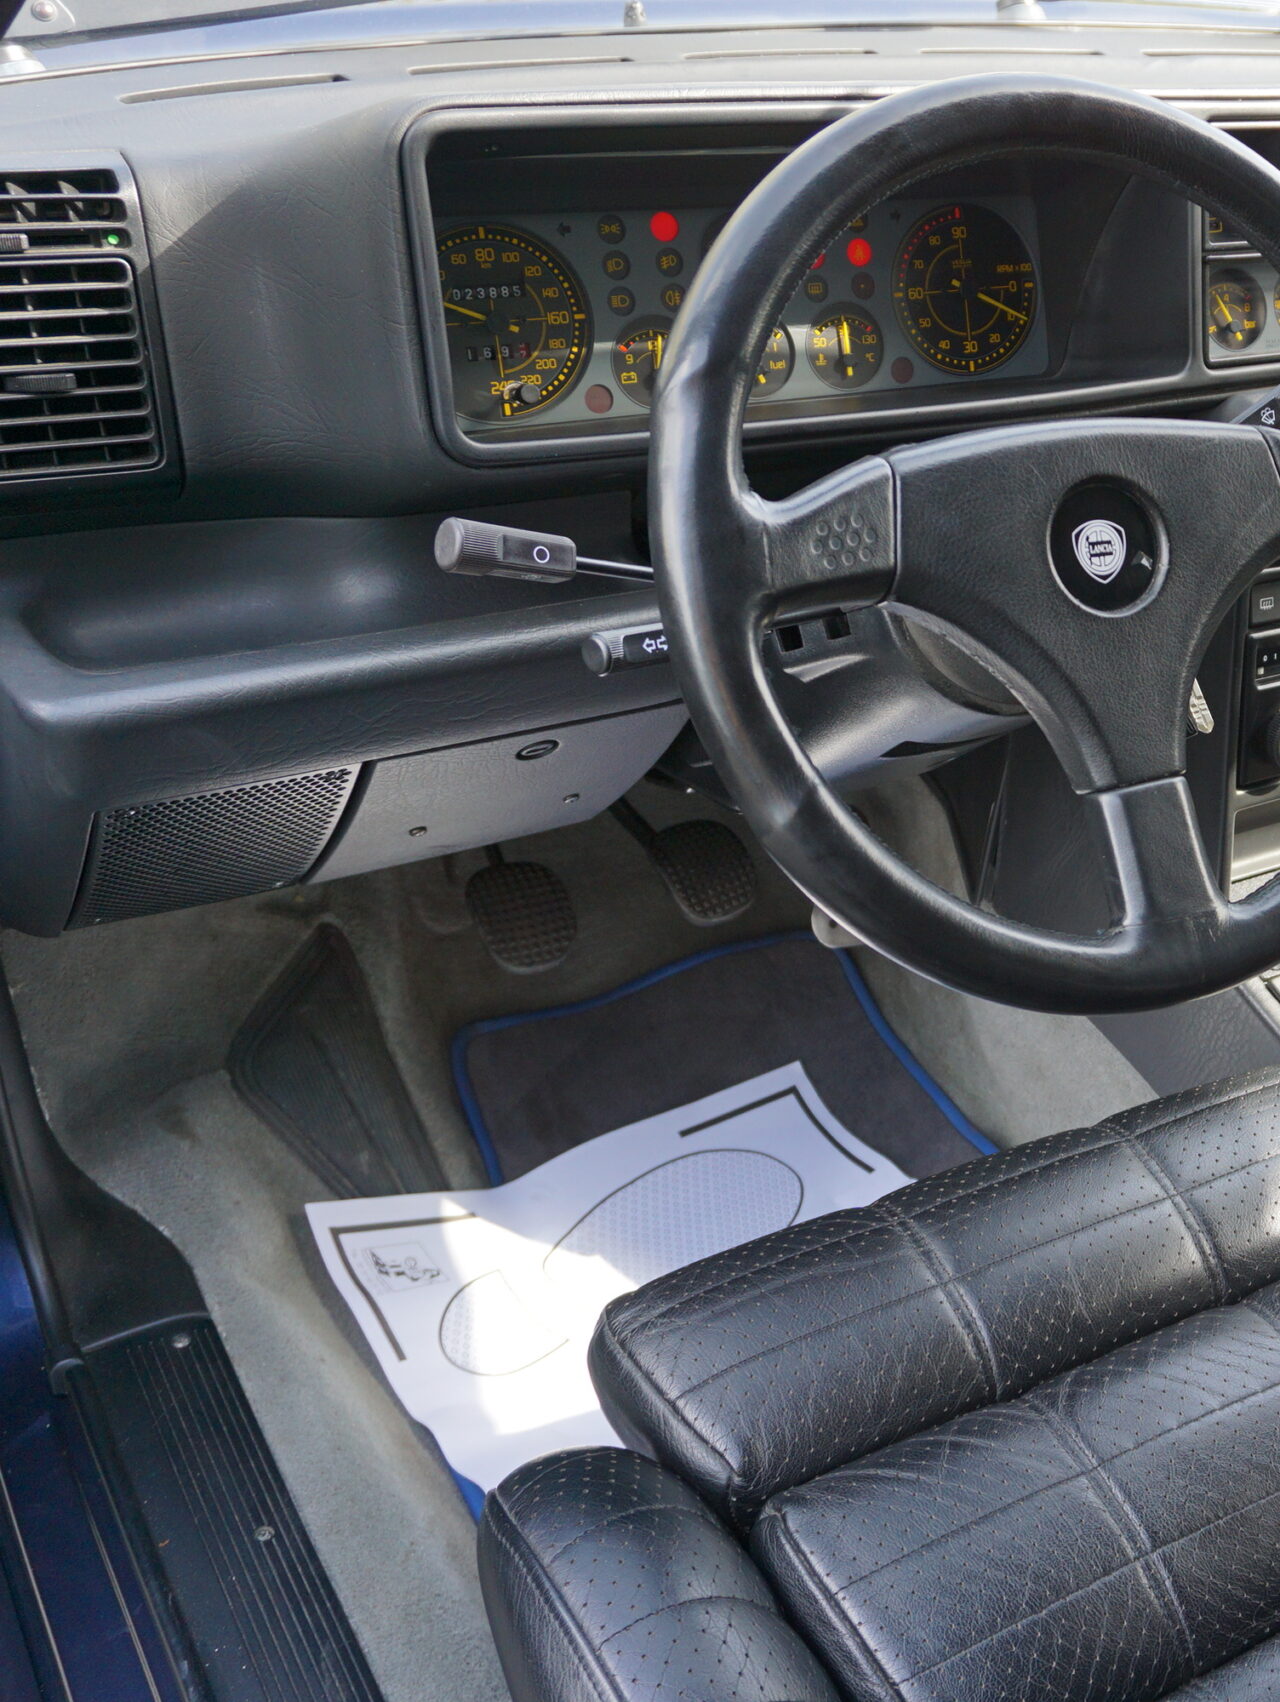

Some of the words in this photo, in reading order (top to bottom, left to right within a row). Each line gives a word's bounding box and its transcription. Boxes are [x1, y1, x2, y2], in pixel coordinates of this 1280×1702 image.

[952, 226, 967, 239] 90
[928, 235, 941, 246] 80
[474, 247, 495, 262] 80
[502, 251, 520, 263] 100
[912, 259, 924, 270] 70
[524, 265, 542, 277] 120
[452, 285, 522, 301] 023885
[542, 287, 559, 298] 140
[908, 287, 924, 300] 60
[547, 310, 570, 325] 160
[918, 317, 932, 328] 50
[548, 338, 566, 349] 180
[812, 337, 827, 348] 50
[862, 334, 877, 345] 130
[989, 333, 1001, 343] 20
[939, 339, 951, 350] 40
[963, 340, 979, 353] 30
[535, 358, 558, 370] 200
[625, 353, 634, 365] 9
[769, 359, 786, 370] fuel
[1089, 543, 1113, 554] LANCIA
[1262, 654, 1269, 662] 0
[1273, 652, 1278, 660] 1
